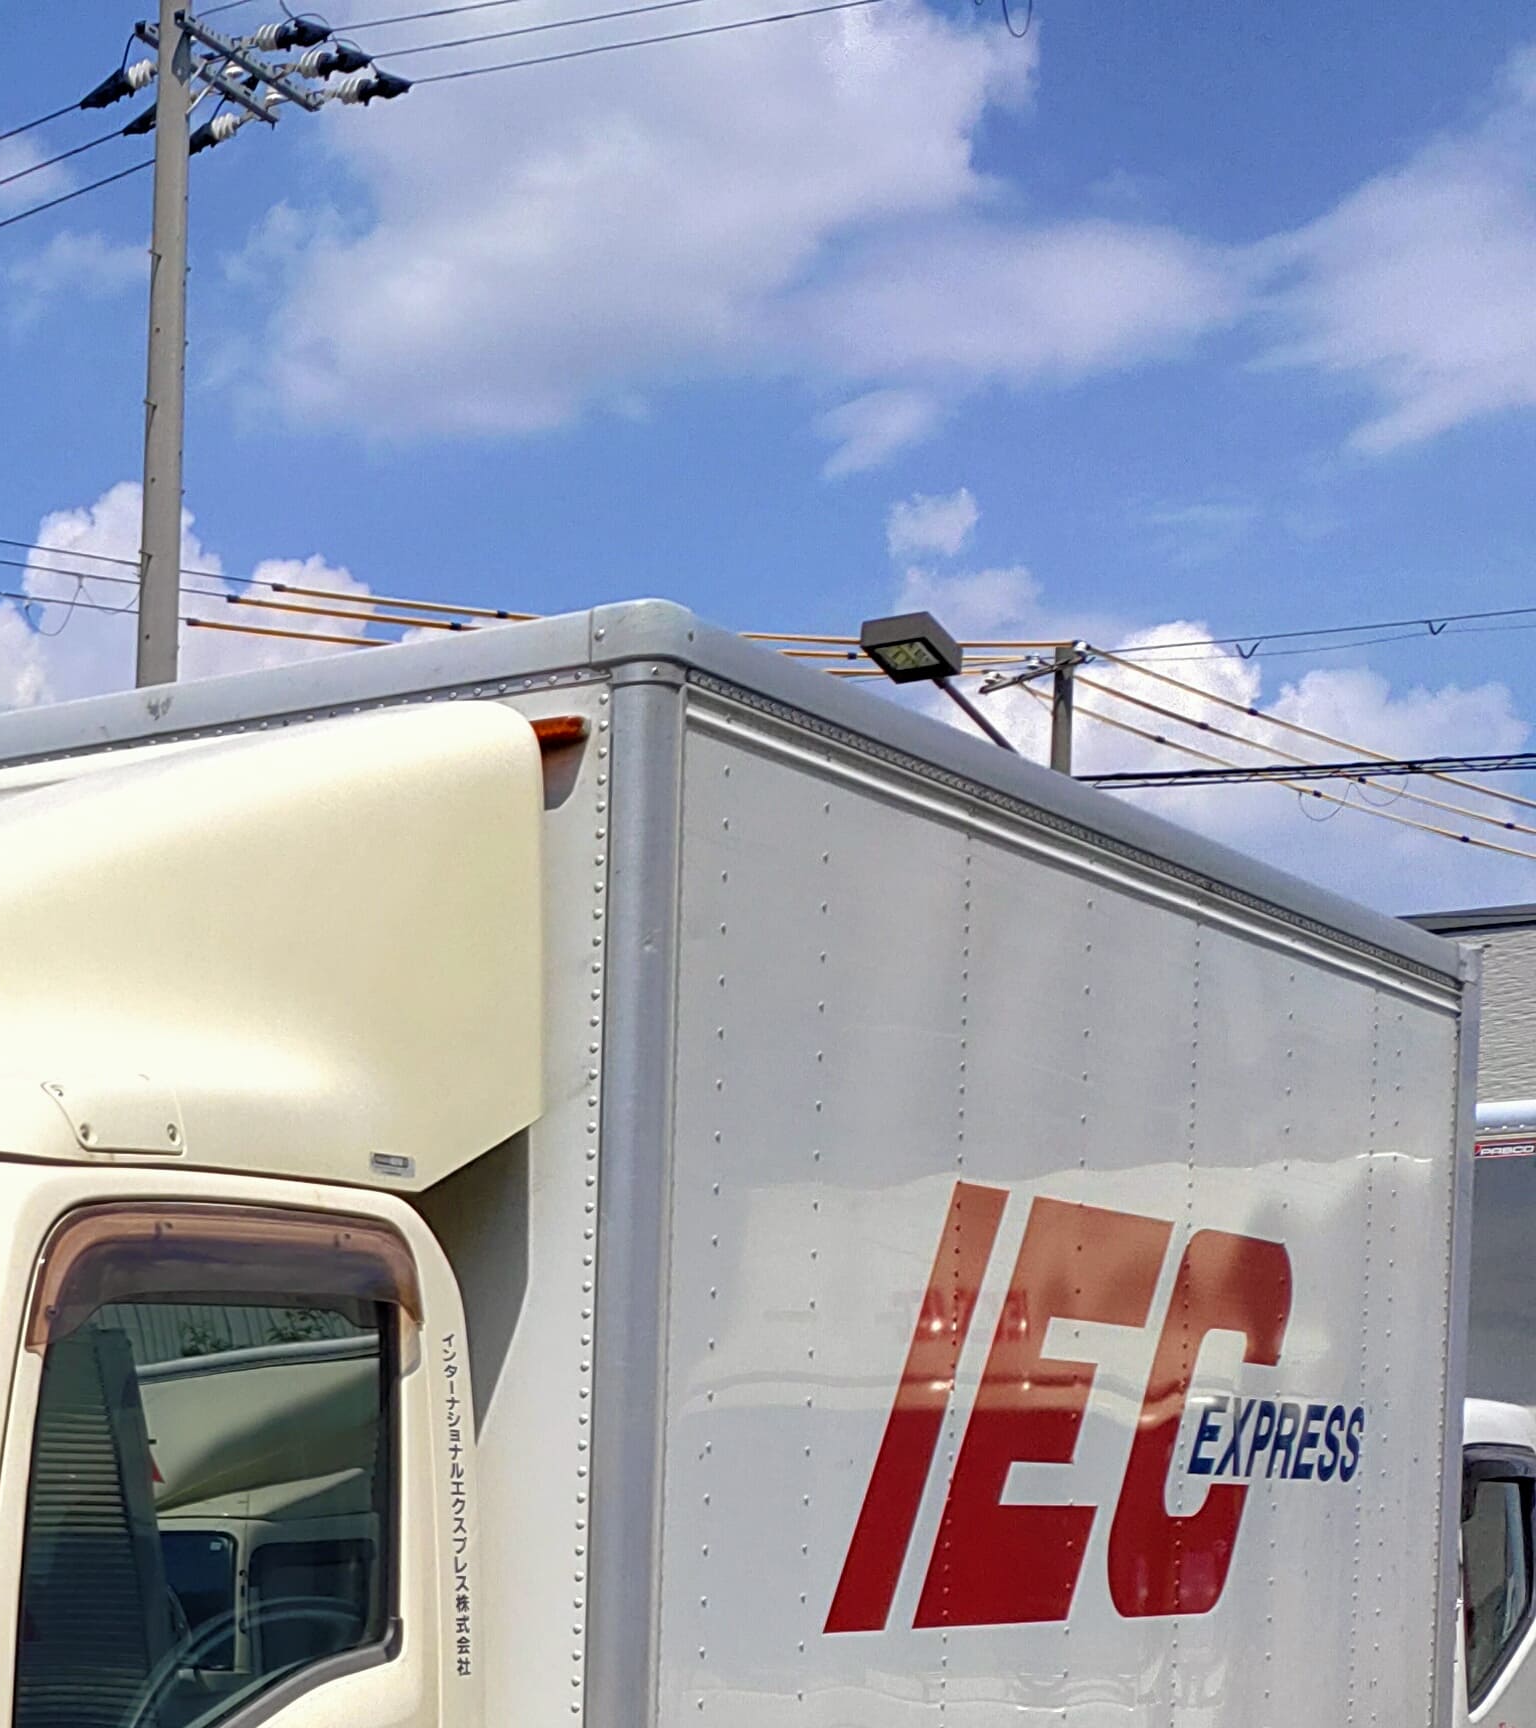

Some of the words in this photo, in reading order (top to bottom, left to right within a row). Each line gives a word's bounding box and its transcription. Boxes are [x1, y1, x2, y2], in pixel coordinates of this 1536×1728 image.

[442, 1333, 471, 1677] インターナショナルエクスプレス株式会社
[823, 1181, 1292, 1634] IEC
[1187, 1396, 1365, 1482] EXPRESS
